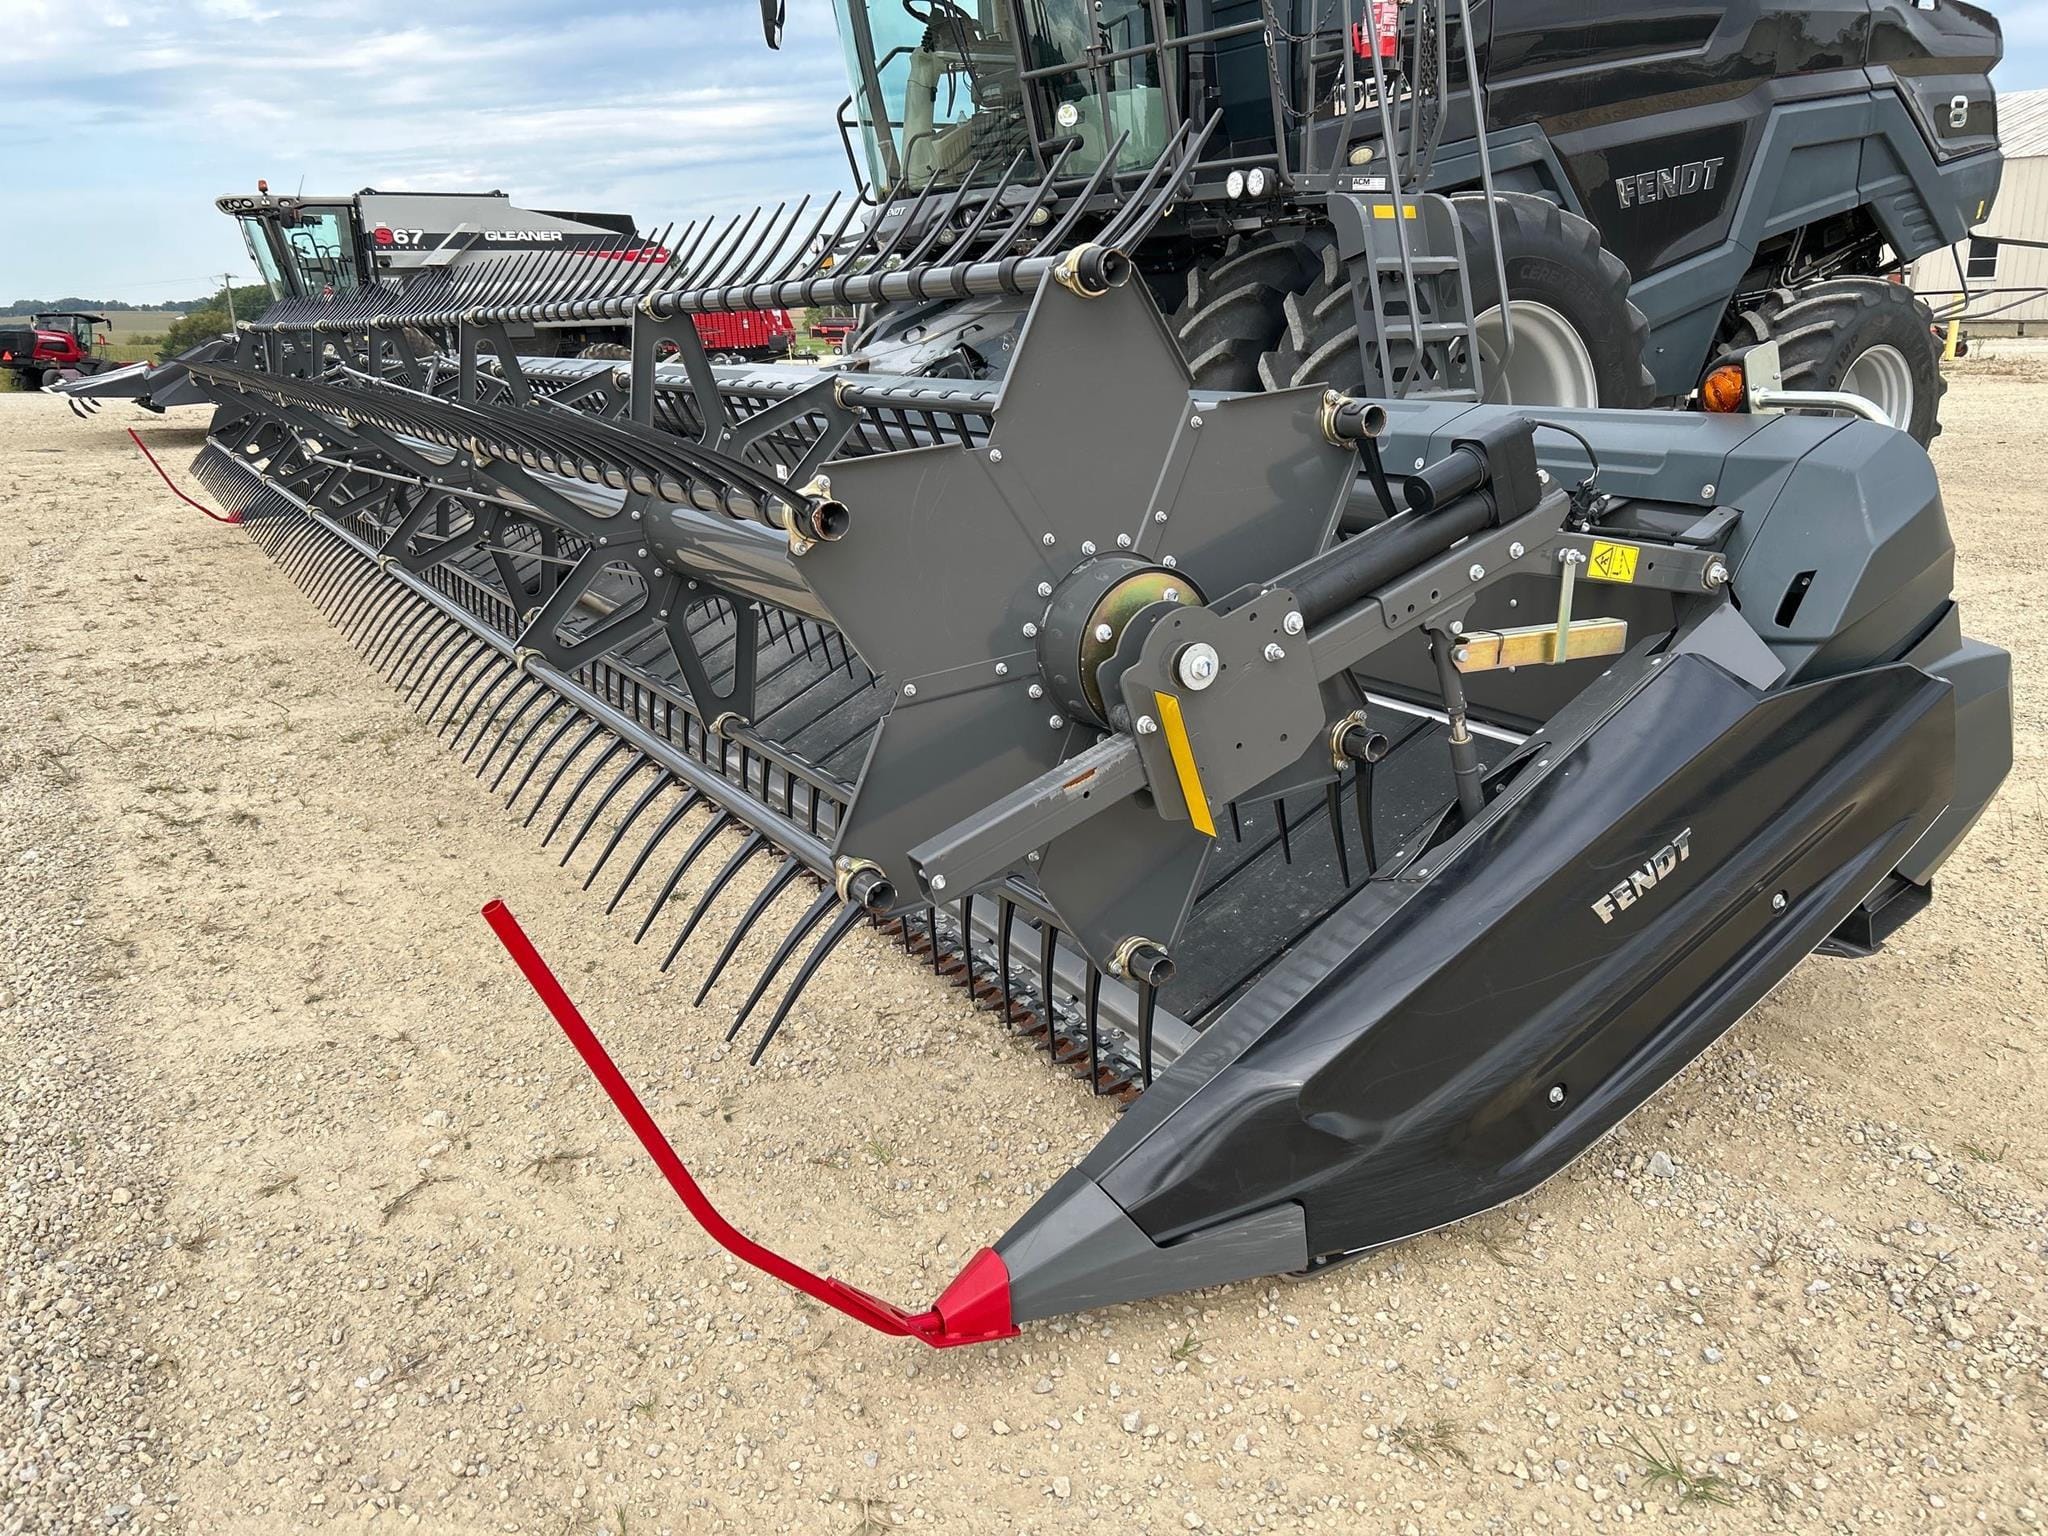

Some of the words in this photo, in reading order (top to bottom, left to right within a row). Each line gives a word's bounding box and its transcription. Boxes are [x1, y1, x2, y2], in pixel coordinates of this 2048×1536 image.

[1334, 72, 1430, 116] IDEA
[1950, 95, 1968, 128] 8
[1615, 157, 1725, 209] FENDT
[884, 206, 907, 217] ENDT
[374, 227, 424, 244] S67
[485, 230, 563, 242] GLEANER
[1591, 827, 1692, 924] FENDT
